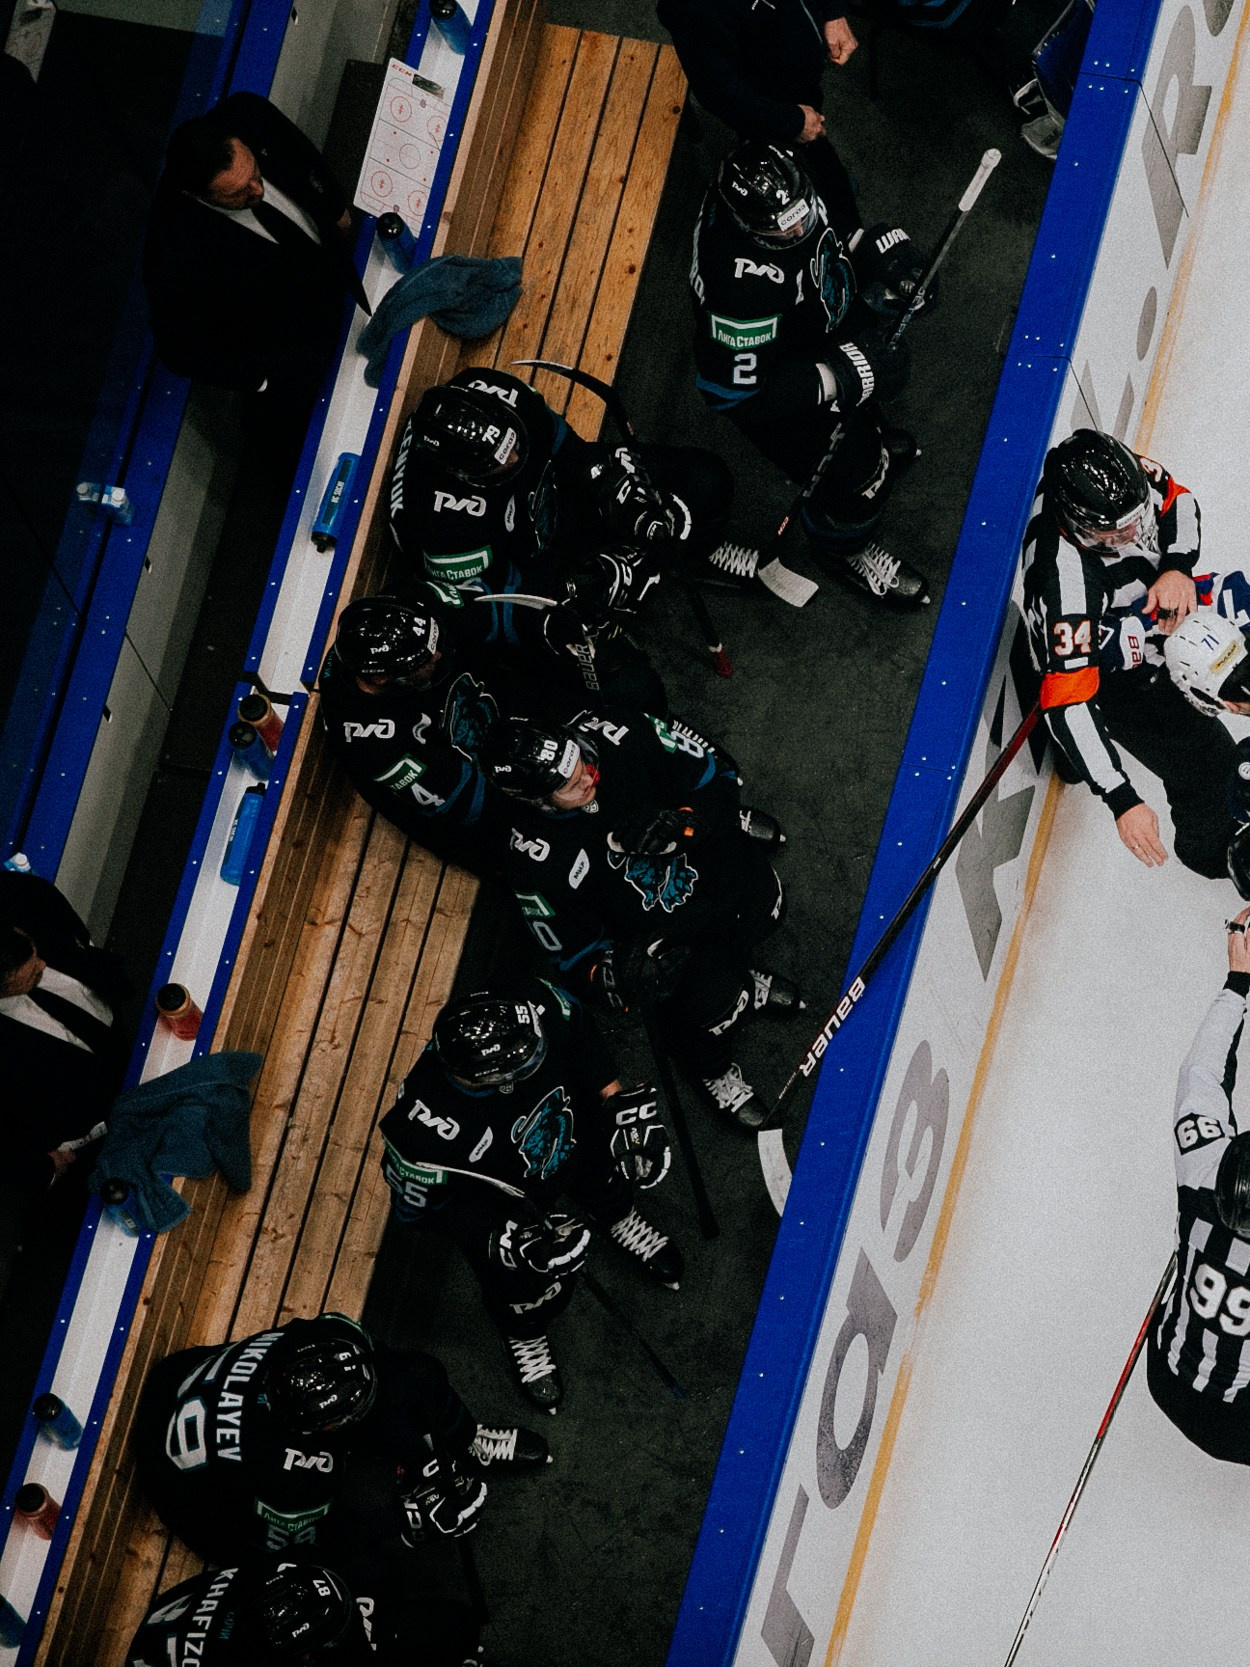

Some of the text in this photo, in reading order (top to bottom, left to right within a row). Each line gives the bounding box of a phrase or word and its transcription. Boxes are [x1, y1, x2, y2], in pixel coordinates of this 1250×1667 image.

[733, 352, 758, 384] 2
[412, 616, 427, 637] 44
[1052, 620, 1092, 656] 34
[1201, 634, 1220, 651] 71
[540, 740, 559, 762] 80
[411, 783, 446, 806] 4
[515, 1005, 530, 1024] 55
[800, 976, 866, 1078] BAUER
[215, 1332, 286, 1462] NIKOLAYEV
